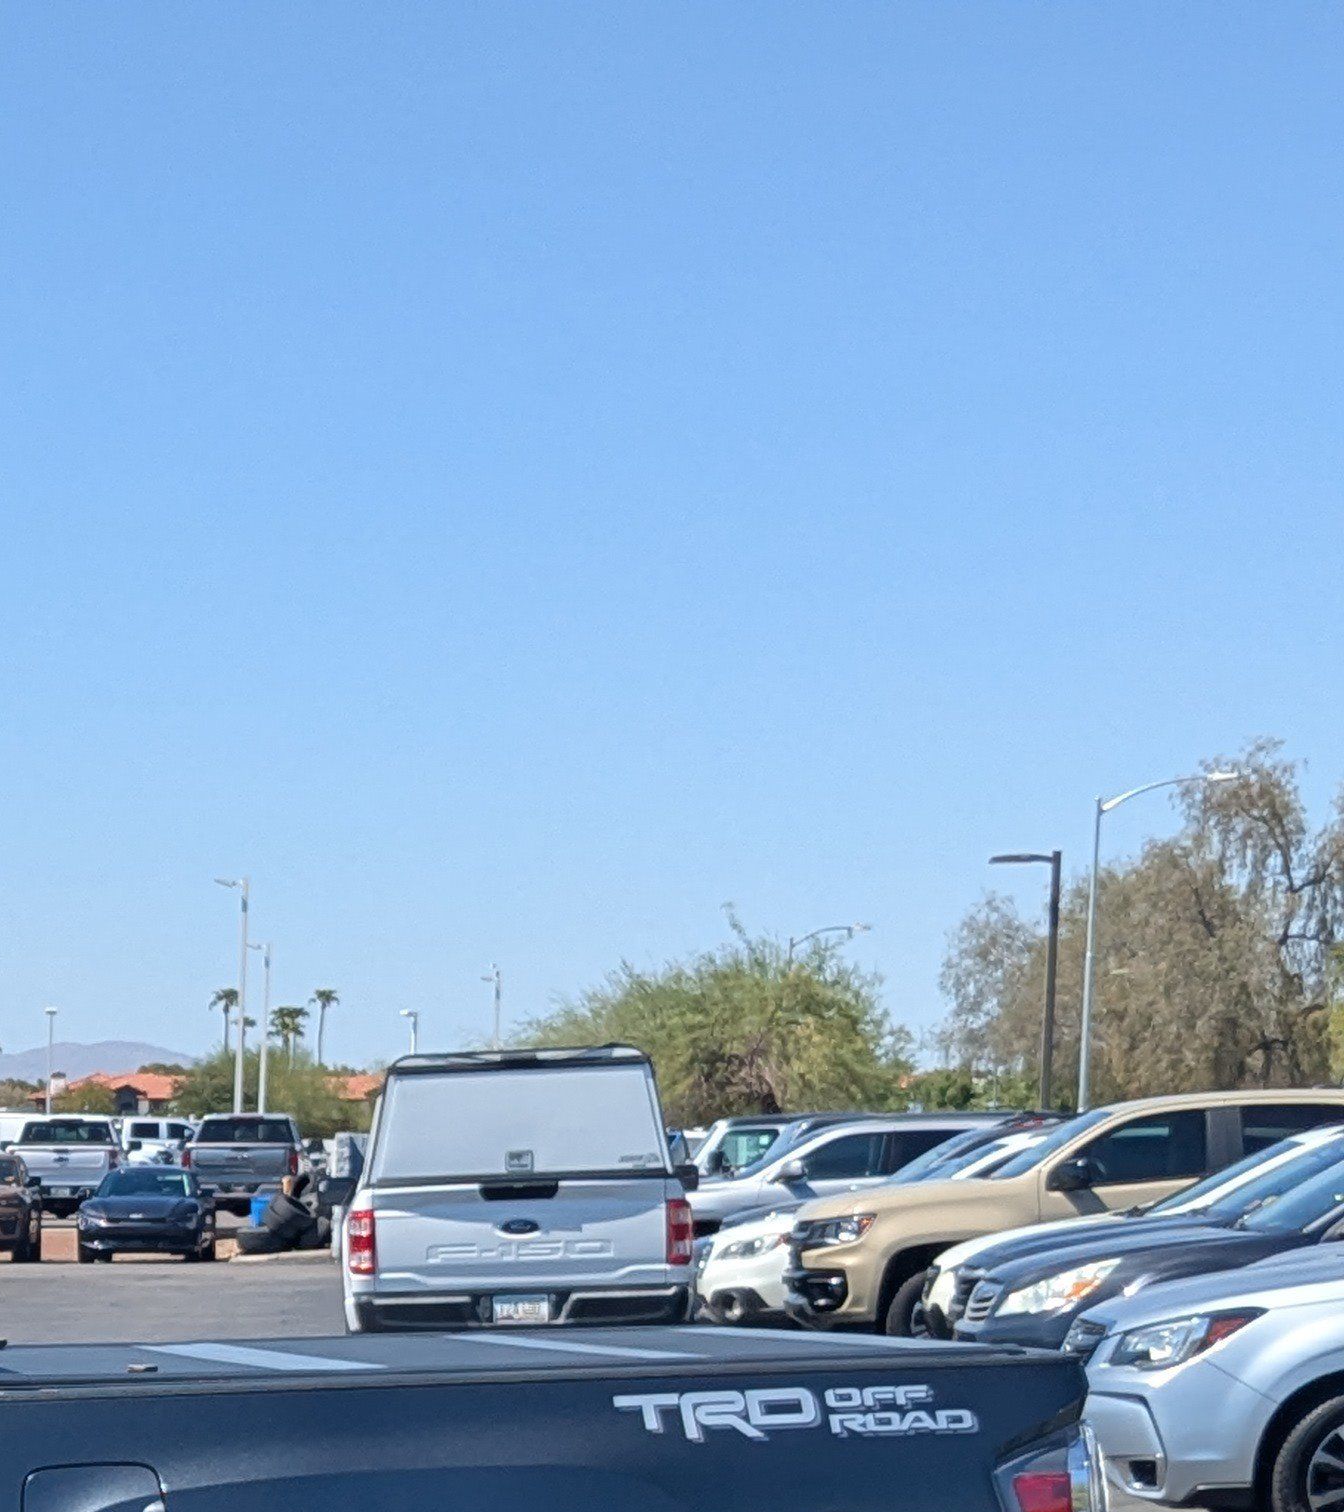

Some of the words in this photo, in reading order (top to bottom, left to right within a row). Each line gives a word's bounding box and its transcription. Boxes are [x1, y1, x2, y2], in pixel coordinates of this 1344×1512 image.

[426, 1239, 614, 1264] F-150
[824, 1385, 933, 1410] OFF
[613, 1387, 821, 1443] TRD
[828, 1409, 979, 1437] ROAD
